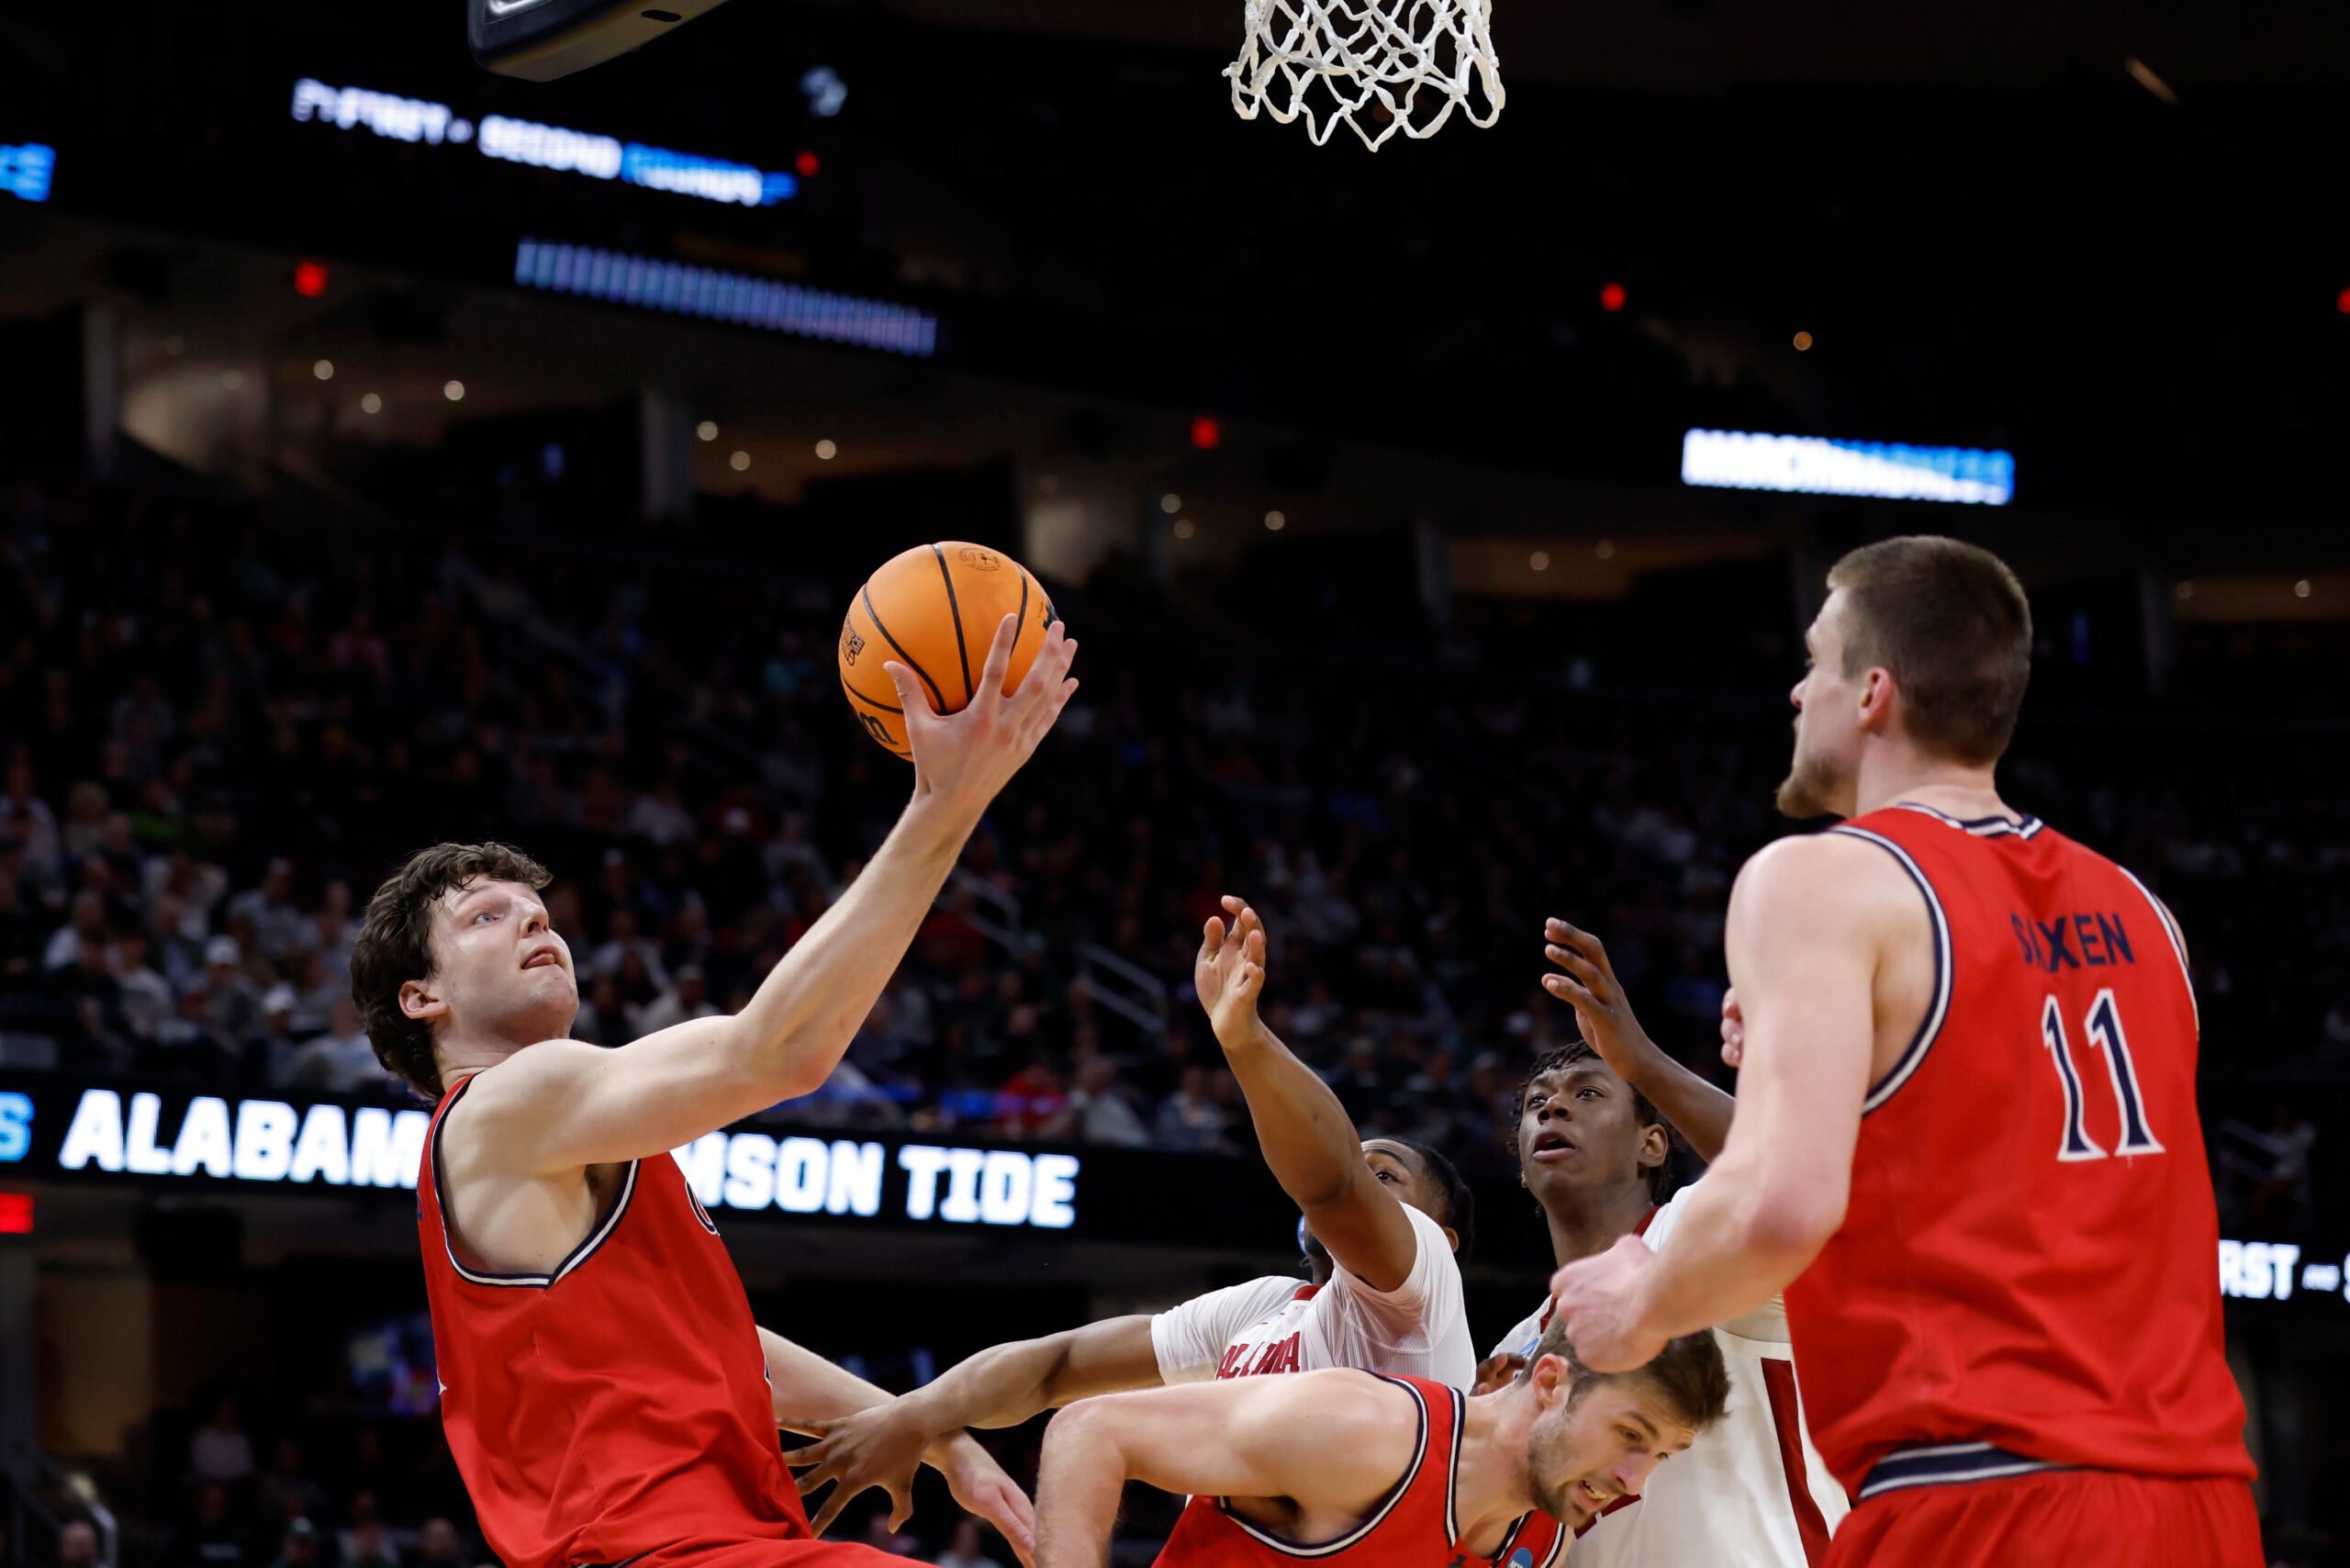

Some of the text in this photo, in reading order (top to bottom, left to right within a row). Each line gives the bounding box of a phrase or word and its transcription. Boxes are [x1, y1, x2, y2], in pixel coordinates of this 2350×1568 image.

[2041, 988, 2166, 1162] 11
[59, 1089, 431, 1190] ALABAM
[669, 1130, 885, 1216] MSON
[899, 1144, 1080, 1228] TIDE
[2218, 1239, 2300, 1301] RST
